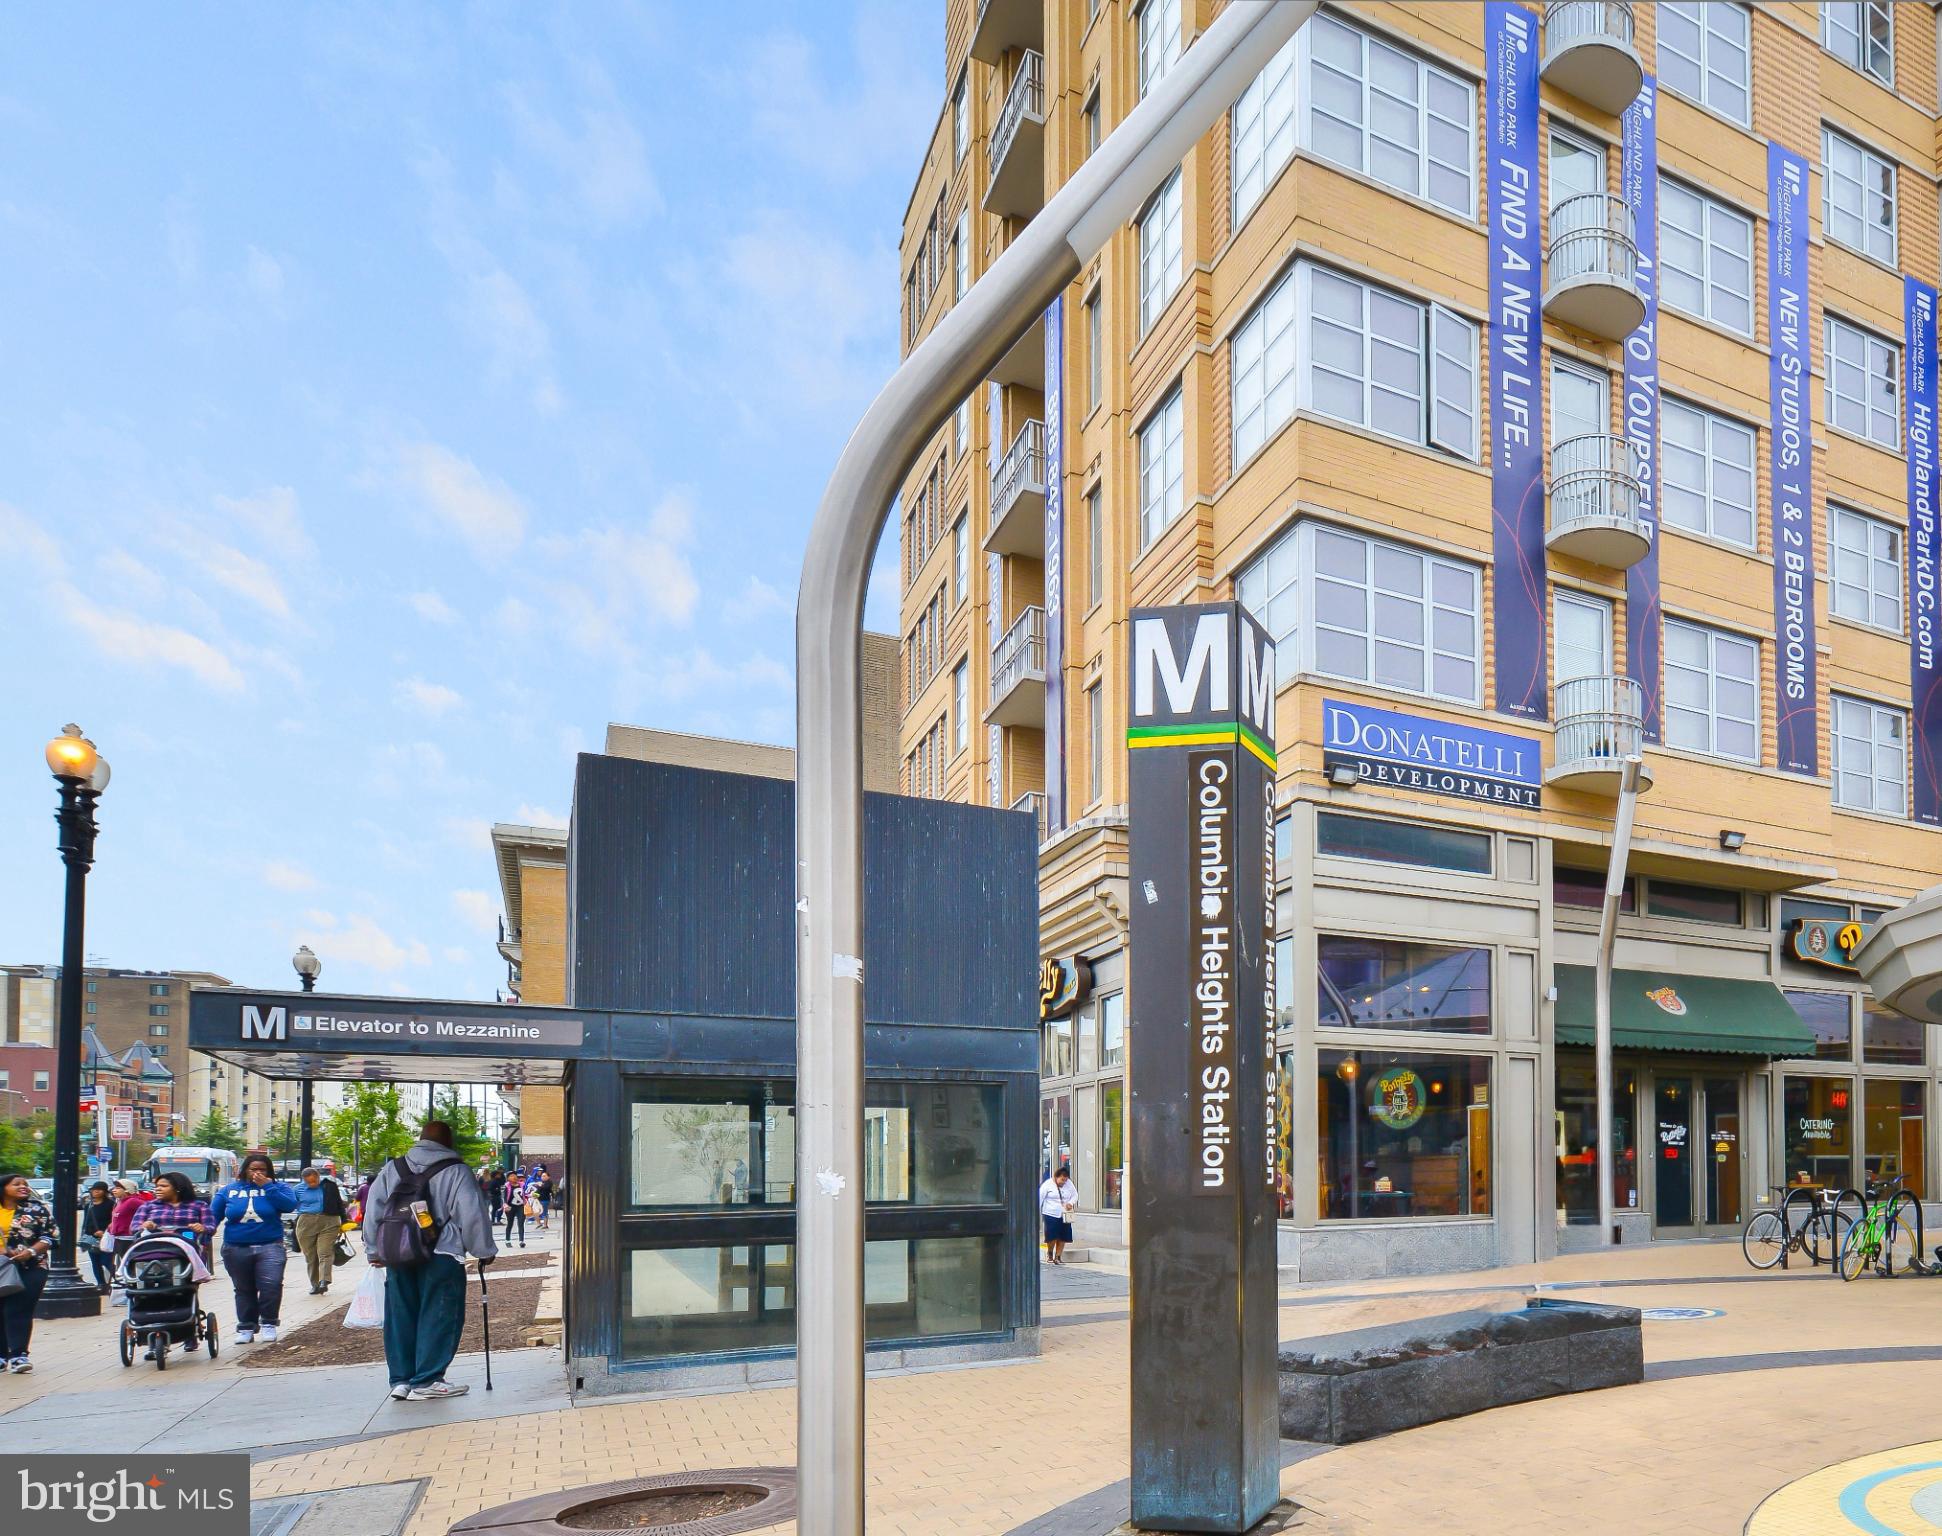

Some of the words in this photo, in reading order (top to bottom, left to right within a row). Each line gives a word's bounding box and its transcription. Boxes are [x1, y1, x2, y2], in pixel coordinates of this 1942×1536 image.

[1506, 35, 1516, 111] HIGHLAND
[1506, 112, 1517, 151] PARK
[1633, 102, 1642, 171] HIGHLAND
[1500, 158, 1529, 240] FIND
[1634, 176, 1642, 208] PARK
[1784, 180, 1792, 245] HIGHLAND
[1502, 243, 1531, 271] A
[1784, 250, 1792, 280] PARK
[1502, 282, 1531, 366] NEW
[1628, 320, 1654, 362] TO
[1779, 287, 1800, 351] NEW
[1917, 308, 1925, 364] HIGHLAND
[1778, 353, 1802, 470] STUDIOS,
[1782, 482, 1802, 495] 1
[1782, 501, 1802, 522] &
[1784, 527, 1803, 546] 2
[1910, 402, 1934, 670] HighlandParkDC.com
[1784, 550, 1805, 700] BEDROOMS
[1134, 613, 1228, 717] M
[1241, 616, 1275, 742] M
[1328, 708, 1525, 777] DONATELLI
[1358, 761, 1538, 805] DEVELOPMENT
[1200, 759, 1228, 915] Columbi
[1264, 781, 1275, 928] Columbia
[241, 1005, 287, 1040] M
[1196, 927, 1230, 1054] Heights
[1264, 939, 1276, 1060] Heights
[315, 1016, 403, 1034] Elevator
[409, 1018, 429, 1036] to
[436, 1020, 541, 1039] Mezzanine
[1202, 1066, 1230, 1187] Station
[1264, 1071, 1276, 1185] Station
[1800, 1118, 1834, 1130] CATERING
